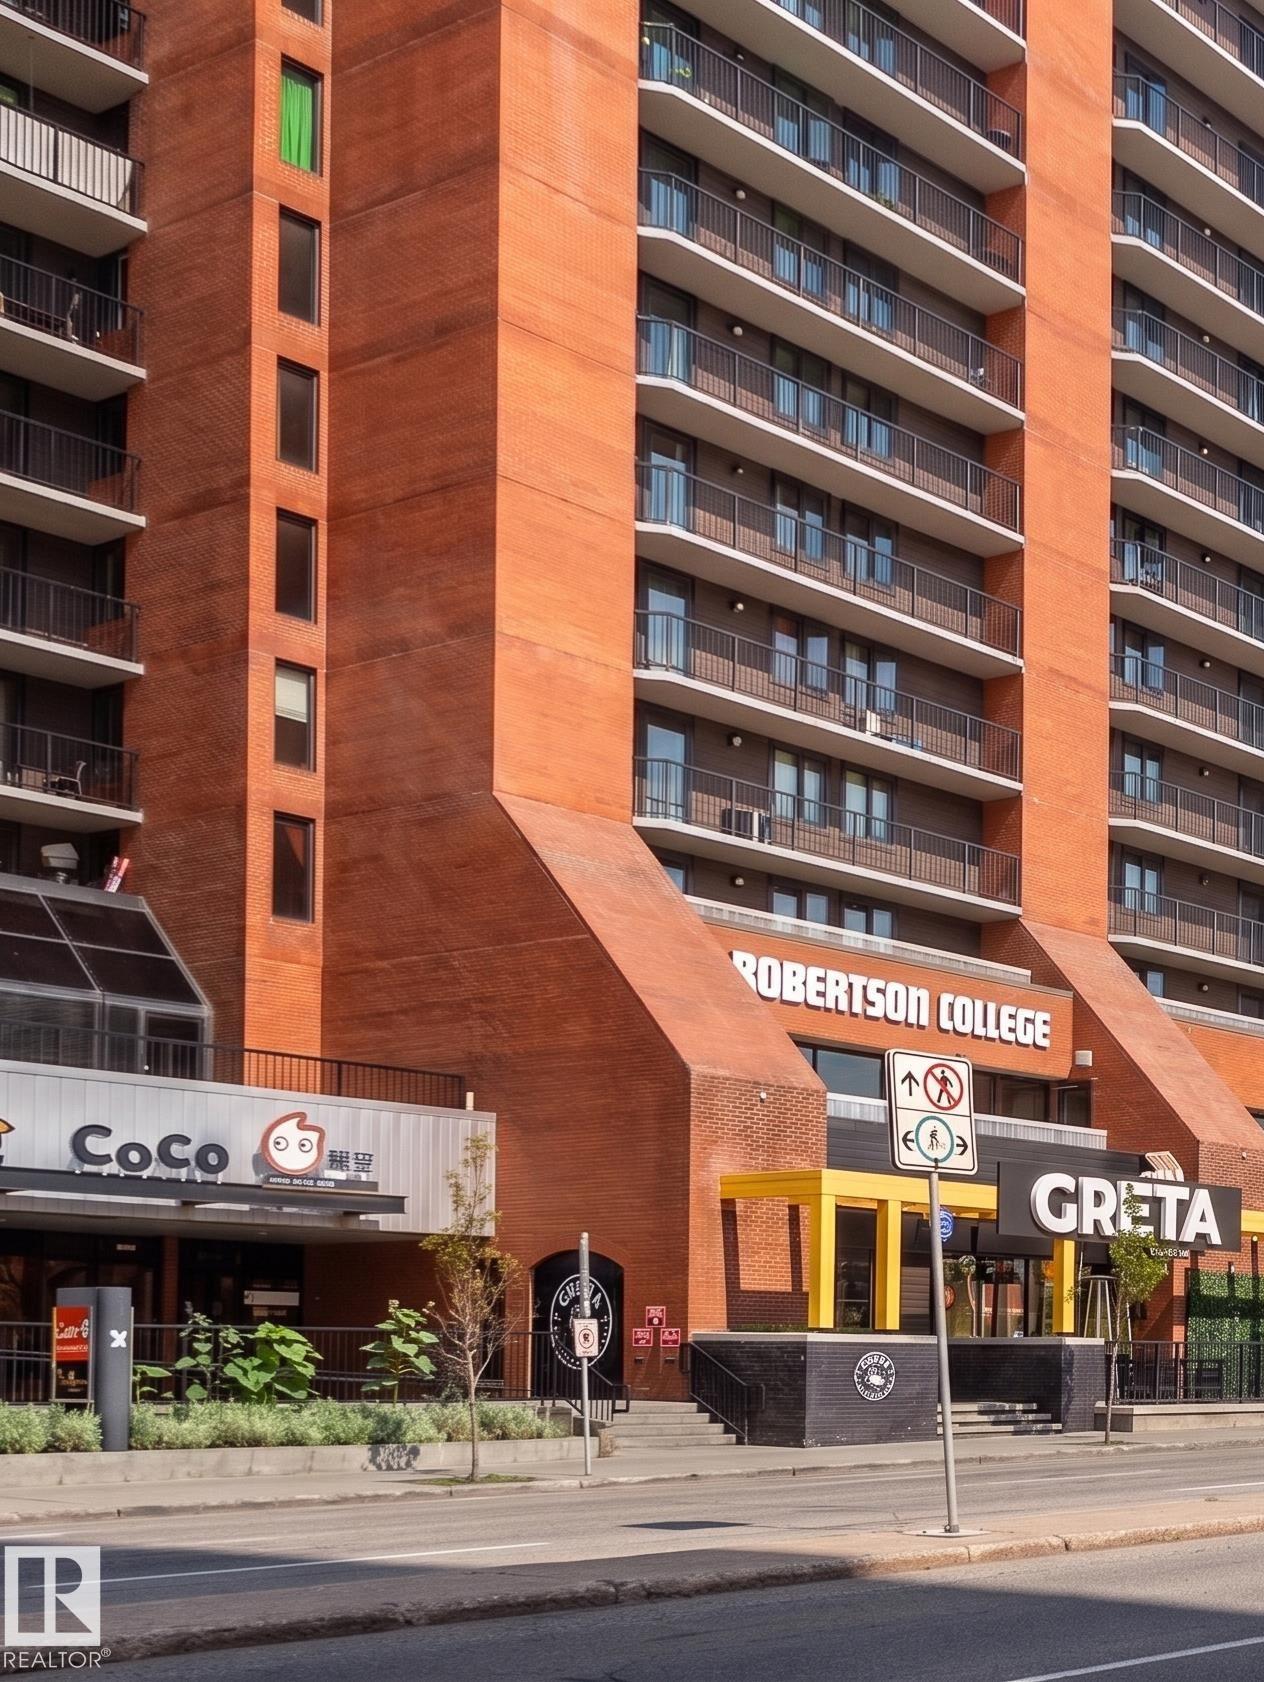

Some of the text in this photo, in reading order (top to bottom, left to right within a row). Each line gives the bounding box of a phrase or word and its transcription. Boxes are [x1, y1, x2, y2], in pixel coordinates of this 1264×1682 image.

[732, 950, 1051, 1049] ROBERTSON COLLEGE
[71, 1124, 230, 1175] CoCo
[1031, 1172, 1222, 1246] GRETA
